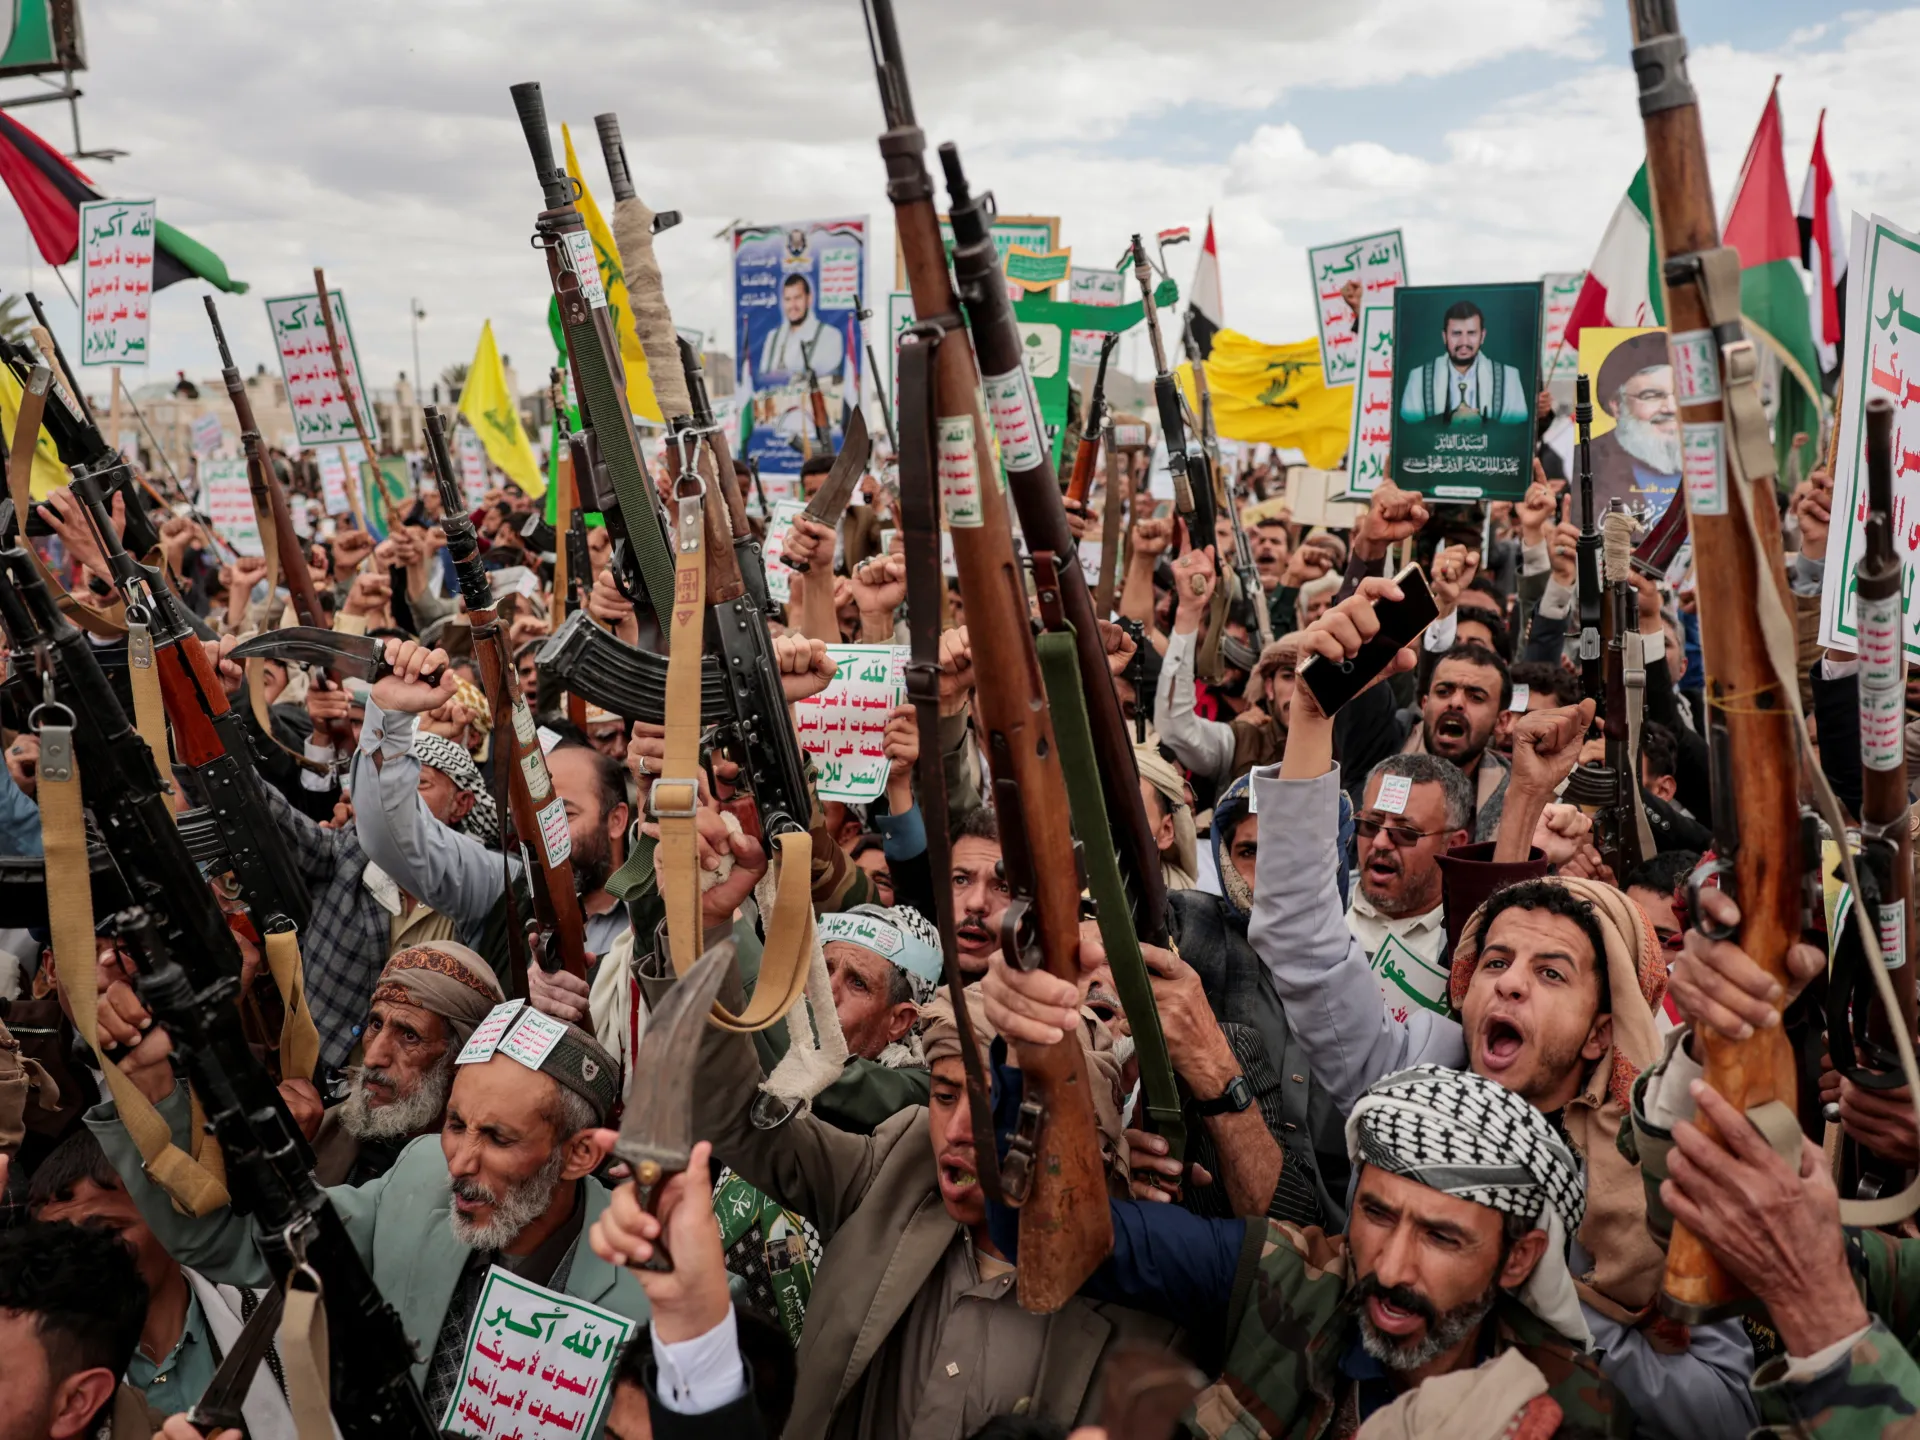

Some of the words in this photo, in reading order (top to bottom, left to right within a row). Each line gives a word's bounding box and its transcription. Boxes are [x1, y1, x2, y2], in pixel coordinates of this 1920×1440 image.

[89, 208, 129, 247] أكبر
[131, 211, 152, 237] لله
[1319, 245, 1364, 282] أكبر
[1368, 241, 1399, 266] الله
[1366, 271, 1402, 293] الموت
[278, 302, 308, 339] أكبر
[860, 659, 888, 683] لله
[852, 694, 892, 711] الموت
[798, 714, 846, 735] لإسرائيل
[835, 740, 853, 757] على
[845, 763, 883, 788] النصر
[484, 1306, 569, 1344] أكبر
[562, 1322, 616, 1362] الله
[475, 1331, 541, 1376] لأمريكا
[467, 1366, 528, 1416] لإسرائيل
[541, 1363, 599, 1399] الموت
[458, 1397, 496, 1435] اليهود
[527, 1399, 585, 1434] الموت
